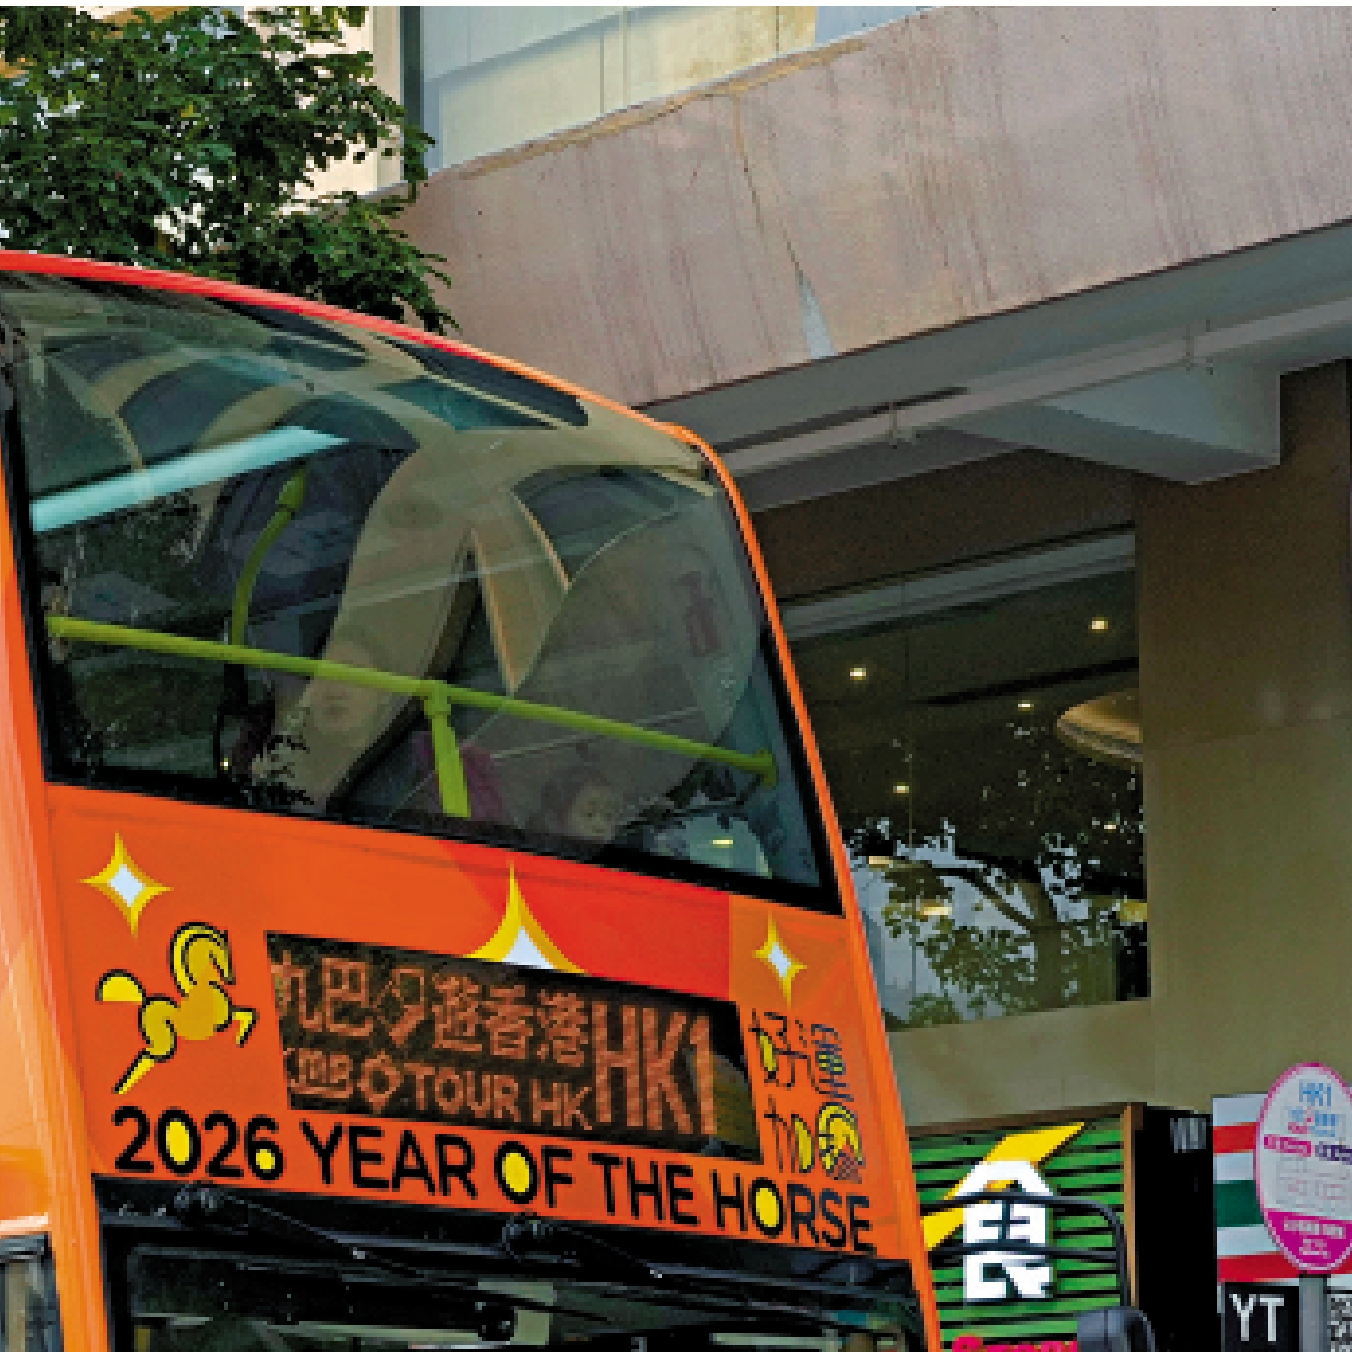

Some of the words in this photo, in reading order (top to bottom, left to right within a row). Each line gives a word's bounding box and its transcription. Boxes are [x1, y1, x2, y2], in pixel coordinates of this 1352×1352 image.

[404, 1062, 521, 1122] TOUR
[532, 1078, 593, 1130] HK
[595, 1000, 717, 1135] HK1
[111, 1106, 284, 1182] 2026
[299, 1121, 478, 1199] YEAR
[494, 1141, 574, 1208] OF
[591, 1152, 701, 1226] THE
[712, 1168, 877, 1256] HORSE
[1229, 1294, 1285, 1341] YT
